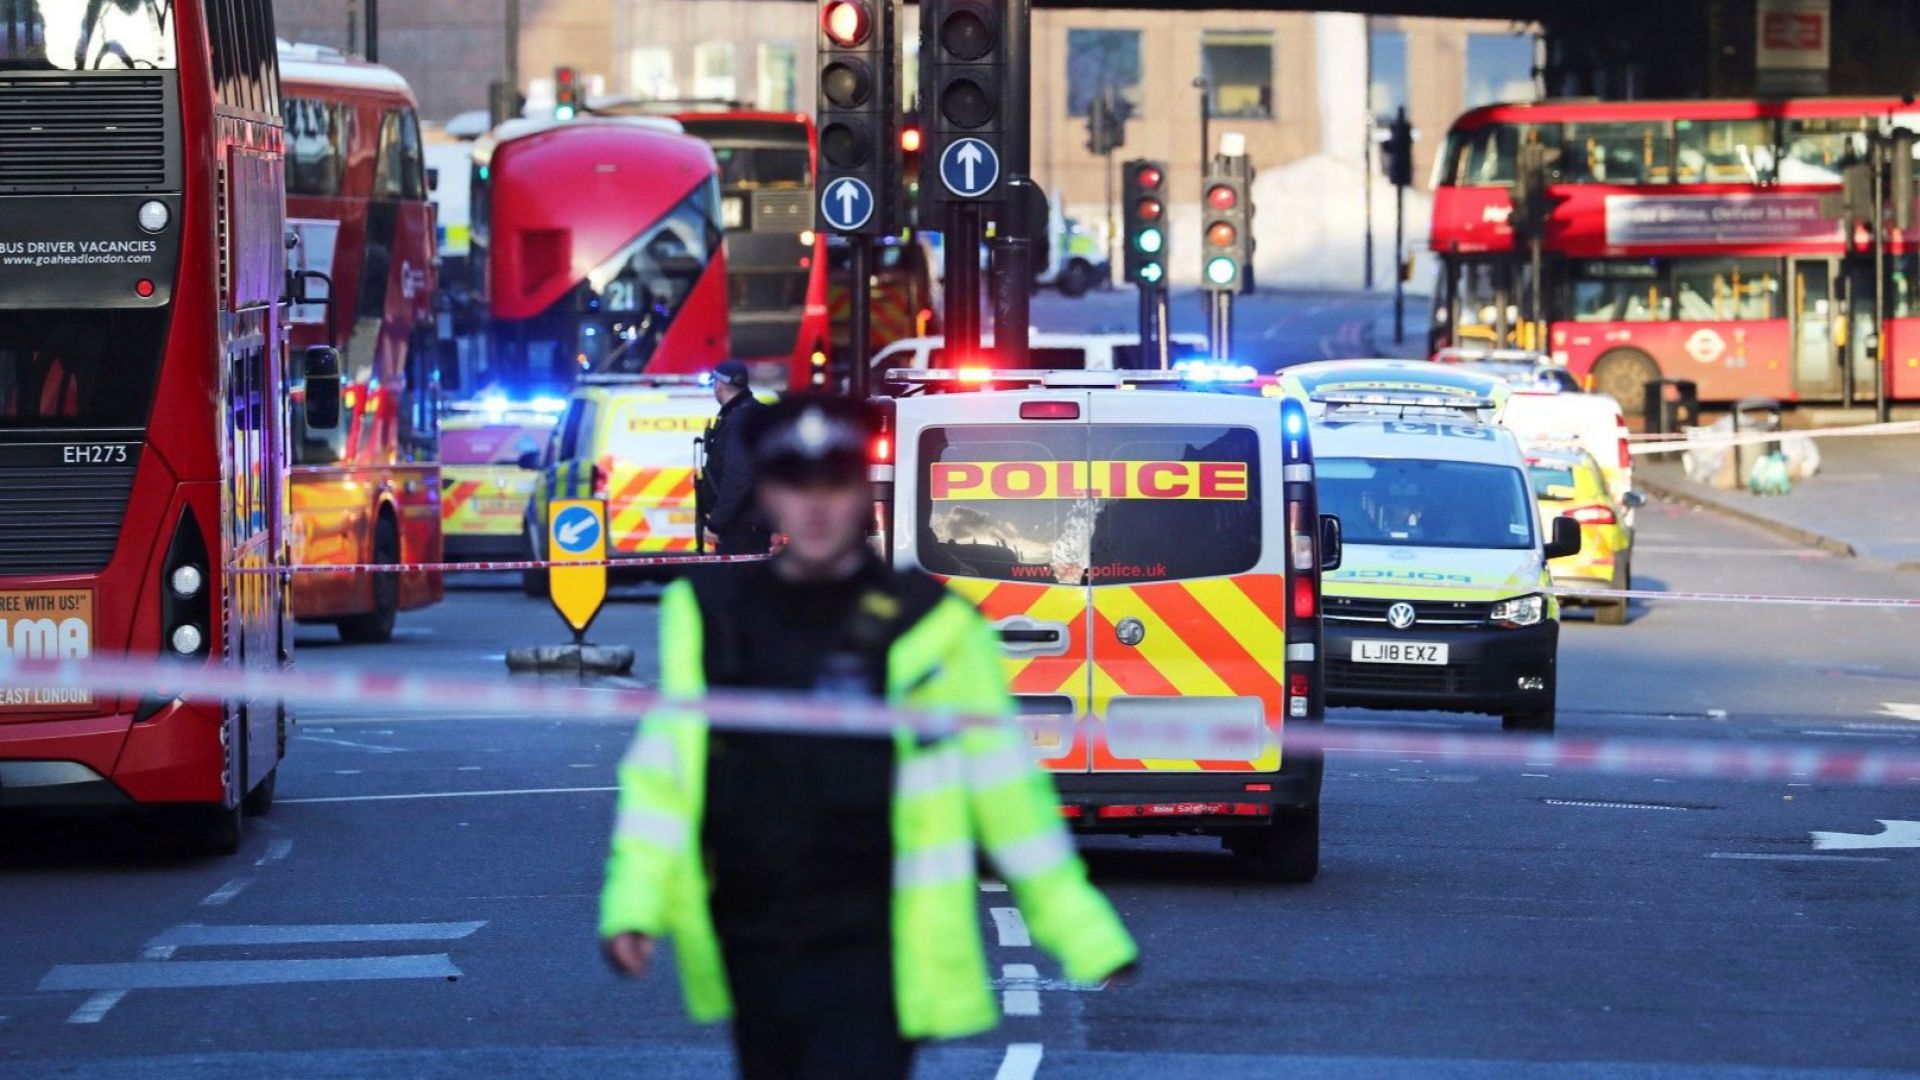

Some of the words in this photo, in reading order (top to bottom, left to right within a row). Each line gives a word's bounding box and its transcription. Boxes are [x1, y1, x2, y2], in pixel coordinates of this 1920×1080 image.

[0, 242, 24, 254] BUS
[28, 242, 75, 253] DRIVER
[79, 241, 157, 252] VACANCIES
[3, 254, 151, 266] www.goaheadlondon.com
[63, 445, 127, 463] EH273
[932, 462, 1246, 499] POLICE
[25, 596, 55, 611] WITH
[1361, 644, 1399, 660] LJ18
[1404, 645, 1437, 662] EXZ
[35, 687, 88, 703] LONDON
